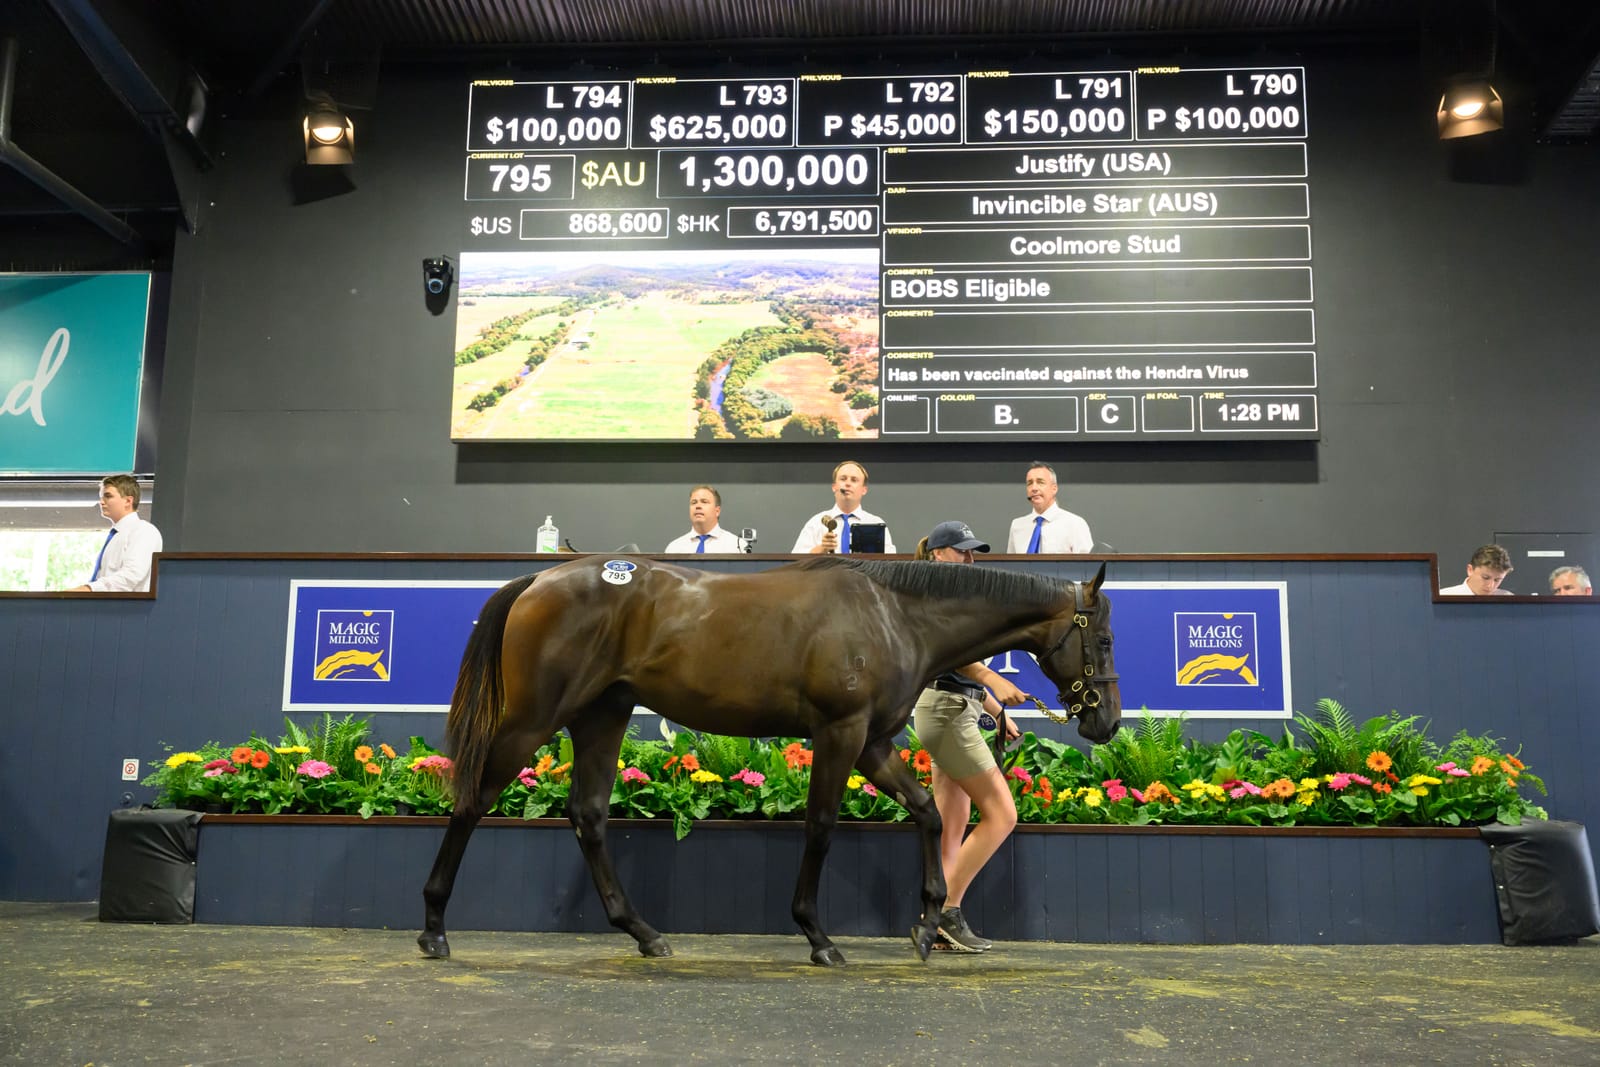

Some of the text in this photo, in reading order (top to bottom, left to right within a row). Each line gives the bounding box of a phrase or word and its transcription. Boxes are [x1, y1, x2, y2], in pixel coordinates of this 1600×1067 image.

[886, 82, 955, 102] L 792
[1056, 78, 1122, 99] L 791
[1227, 74, 1296, 95] L 790
[546, 86, 622, 108] L 794
[720, 85, 787, 106] L 793
[650, 114, 786, 143] $625,000
[824, 114, 955, 139] P $45,000
[984, 108, 1125, 137] $150,000
[1148, 106, 1299, 132] P $100,000
[486, 116, 621, 145] $100,000
[582, 161, 646, 189] $AU
[679, 155, 868, 192] 1,300,000
[1016, 153, 1171, 177] Justify (USA)
[489, 165, 551, 192] 795
[972, 193, 1218, 216] Invincible Star (AUS)
[471, 216, 512, 236] $US
[569, 213, 661, 236] 868,600
[677, 214, 720, 233] $HK
[755, 211, 872, 234] 6,791,500
[1010, 235, 1181, 255] Coolmore Stud
[890, 278, 1050, 301] BOBS Eligible
[0, 328, 70, 426] d
[888, 365, 1249, 382] Has been vaccinated against the Hendra Virus
[994, 405, 1019, 424] B.
[1101, 403, 1119, 424] C
[1218, 404, 1299, 421] 1:28 PM
[608, 572, 626, 580] 795
[329, 622, 380, 635] MAGIC
[1188, 625, 1242, 638] MAGIC
[329, 636, 378, 644] MILLIONS
[1189, 639, 1242, 648] MILLIONS
